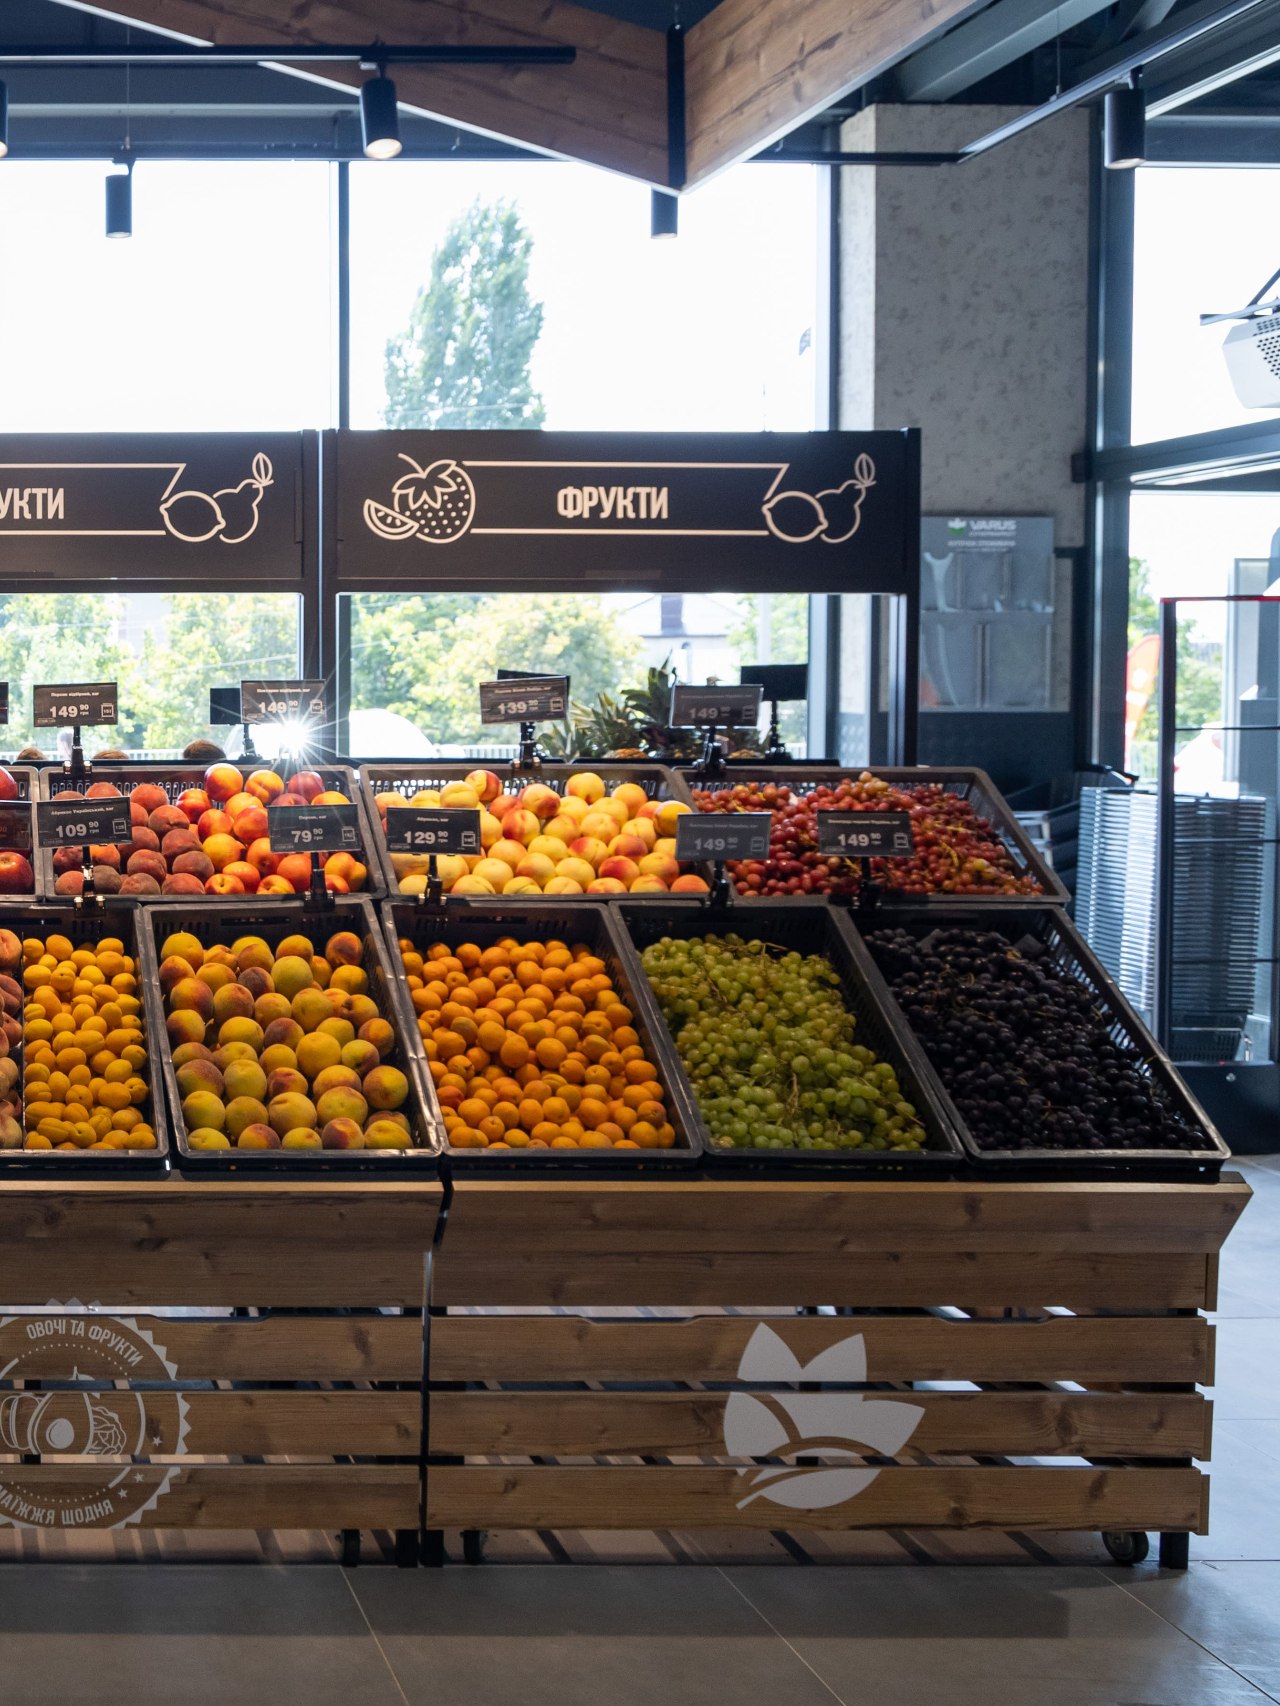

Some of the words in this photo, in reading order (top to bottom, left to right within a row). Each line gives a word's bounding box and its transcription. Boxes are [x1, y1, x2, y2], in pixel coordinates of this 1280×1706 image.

[557, 486, 668, 519] ФРУКТИ
[969, 520, 1016, 530] VARUS
[50, 706, 78, 717] 149
[259, 702, 287, 713] 149
[498, 702, 526, 714] 139
[689, 708, 718, 718] 149
[56, 824, 87, 838] 109
[291, 830, 312, 843] 79
[404, 831, 435, 844] 129
[838, 834, 869, 846] 149
[695, 838, 725, 850] 149
[26, 1320, 66, 1340] ОВОЧІ
[70, 1320, 85, 1336] ТА
[88, 1326, 144, 1366] ФРУКТИ
[61, 1499, 113, 1525] ЩОДНЯ
